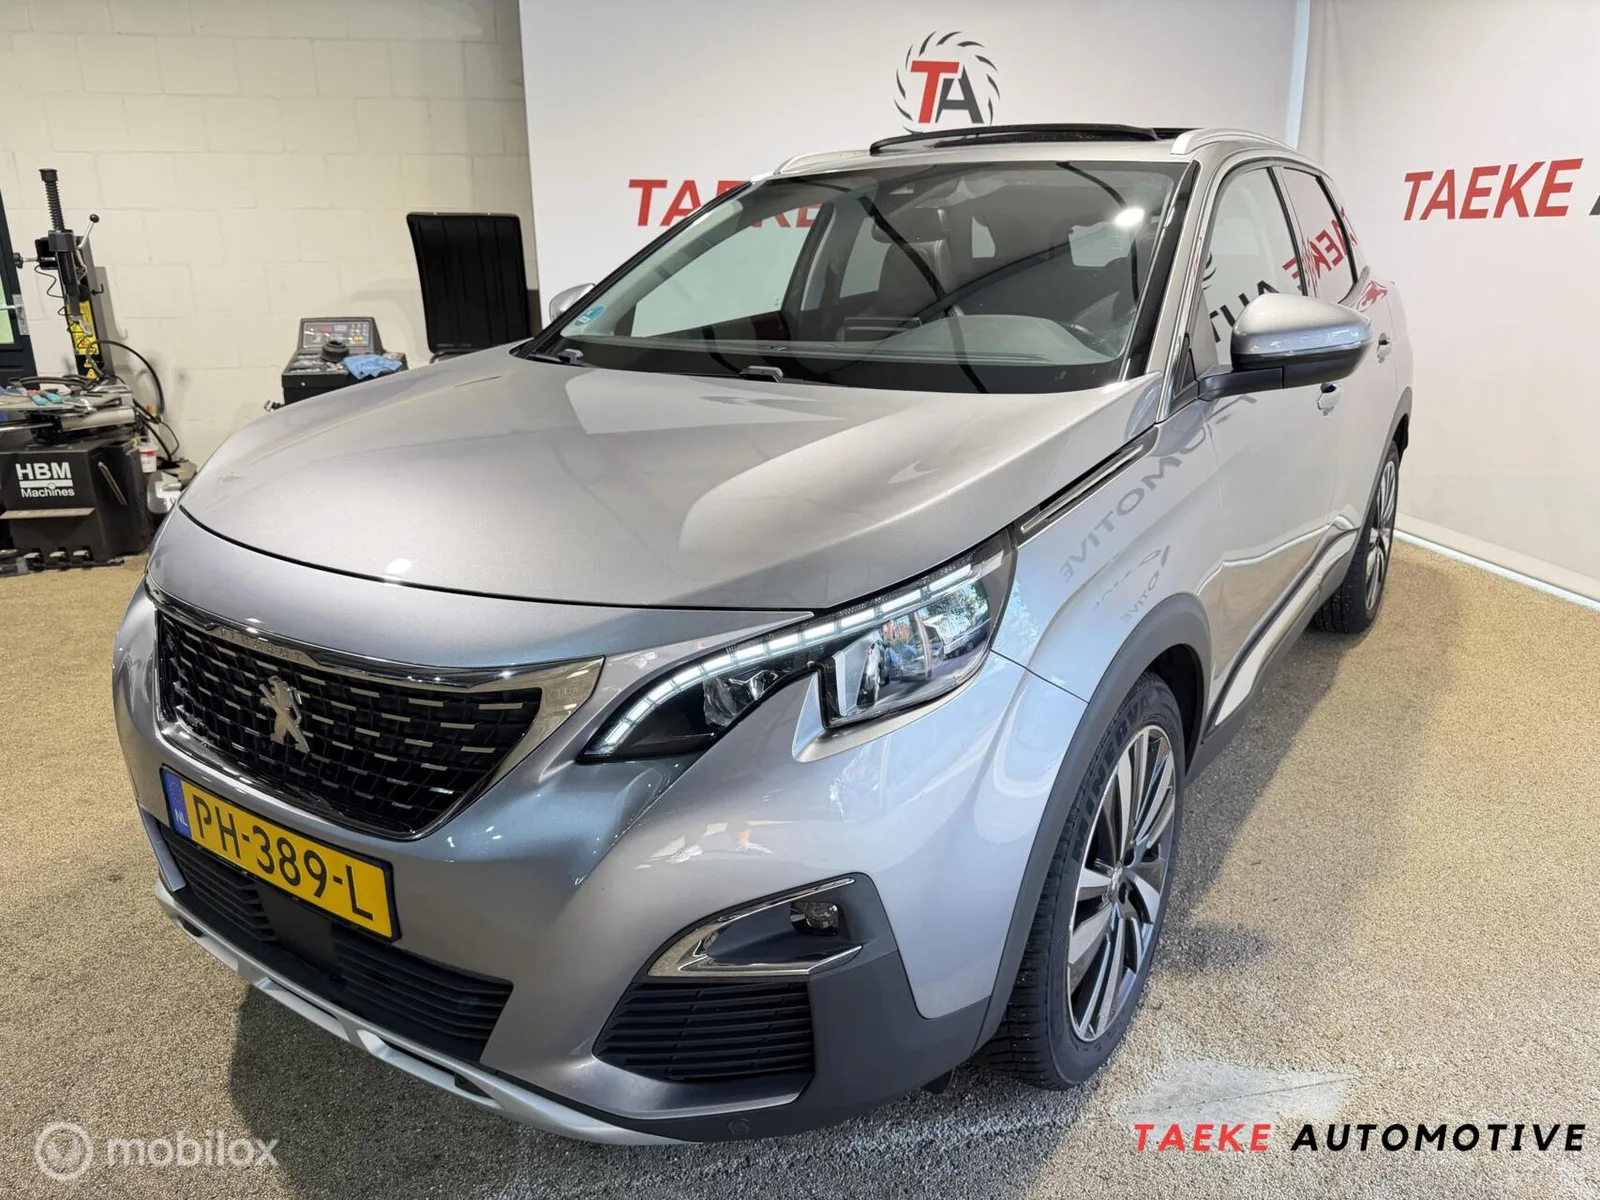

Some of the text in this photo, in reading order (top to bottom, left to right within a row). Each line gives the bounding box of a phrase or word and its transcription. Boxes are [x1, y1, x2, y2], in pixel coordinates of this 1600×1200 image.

[910, 60, 985, 124] TA
[1403, 158, 1583, 221] TAEKE
[15, 462, 72, 480] HBM
[20, 488, 75, 498] Machines
[174, 794, 374, 922] NL PH-389-L
